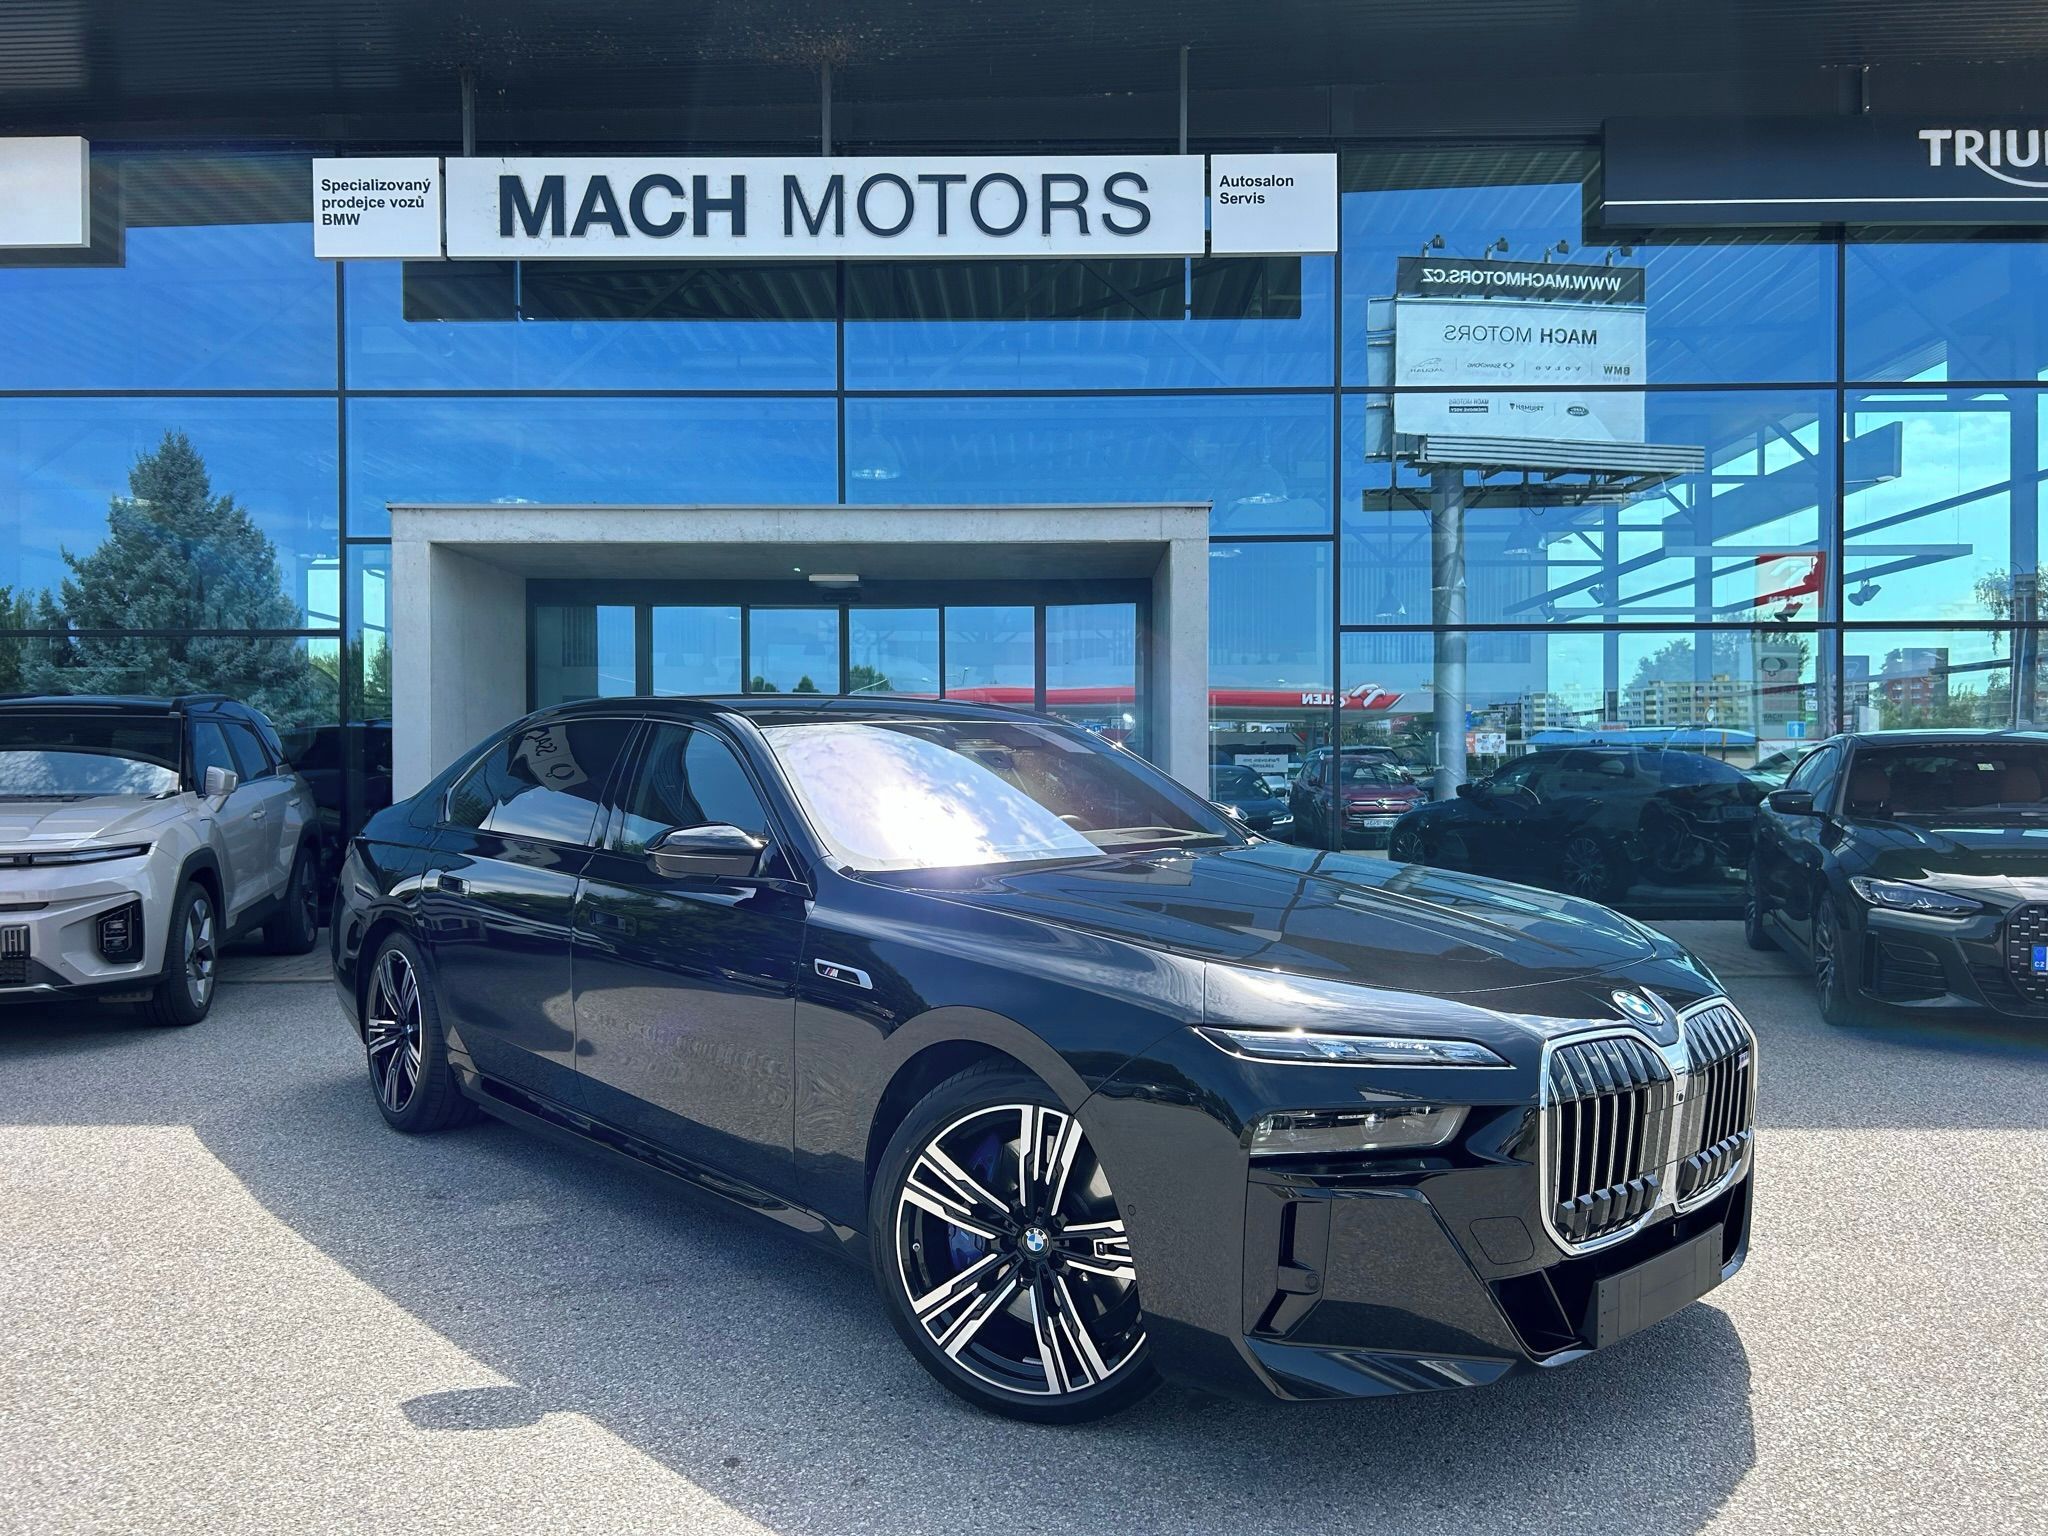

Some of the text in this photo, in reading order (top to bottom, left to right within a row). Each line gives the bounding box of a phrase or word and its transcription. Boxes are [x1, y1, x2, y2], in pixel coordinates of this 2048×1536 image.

[1919, 129, 2048, 187] TRIU
[321, 177, 431, 194] Specializovaný
[1219, 175, 1295, 189] Autosalon
[321, 195, 425, 212] prodejce vozů
[499, 171, 1152, 239] MACH MOTORS
[1219, 192, 1266, 205] Servis
[321, 213, 361, 227] BMW
